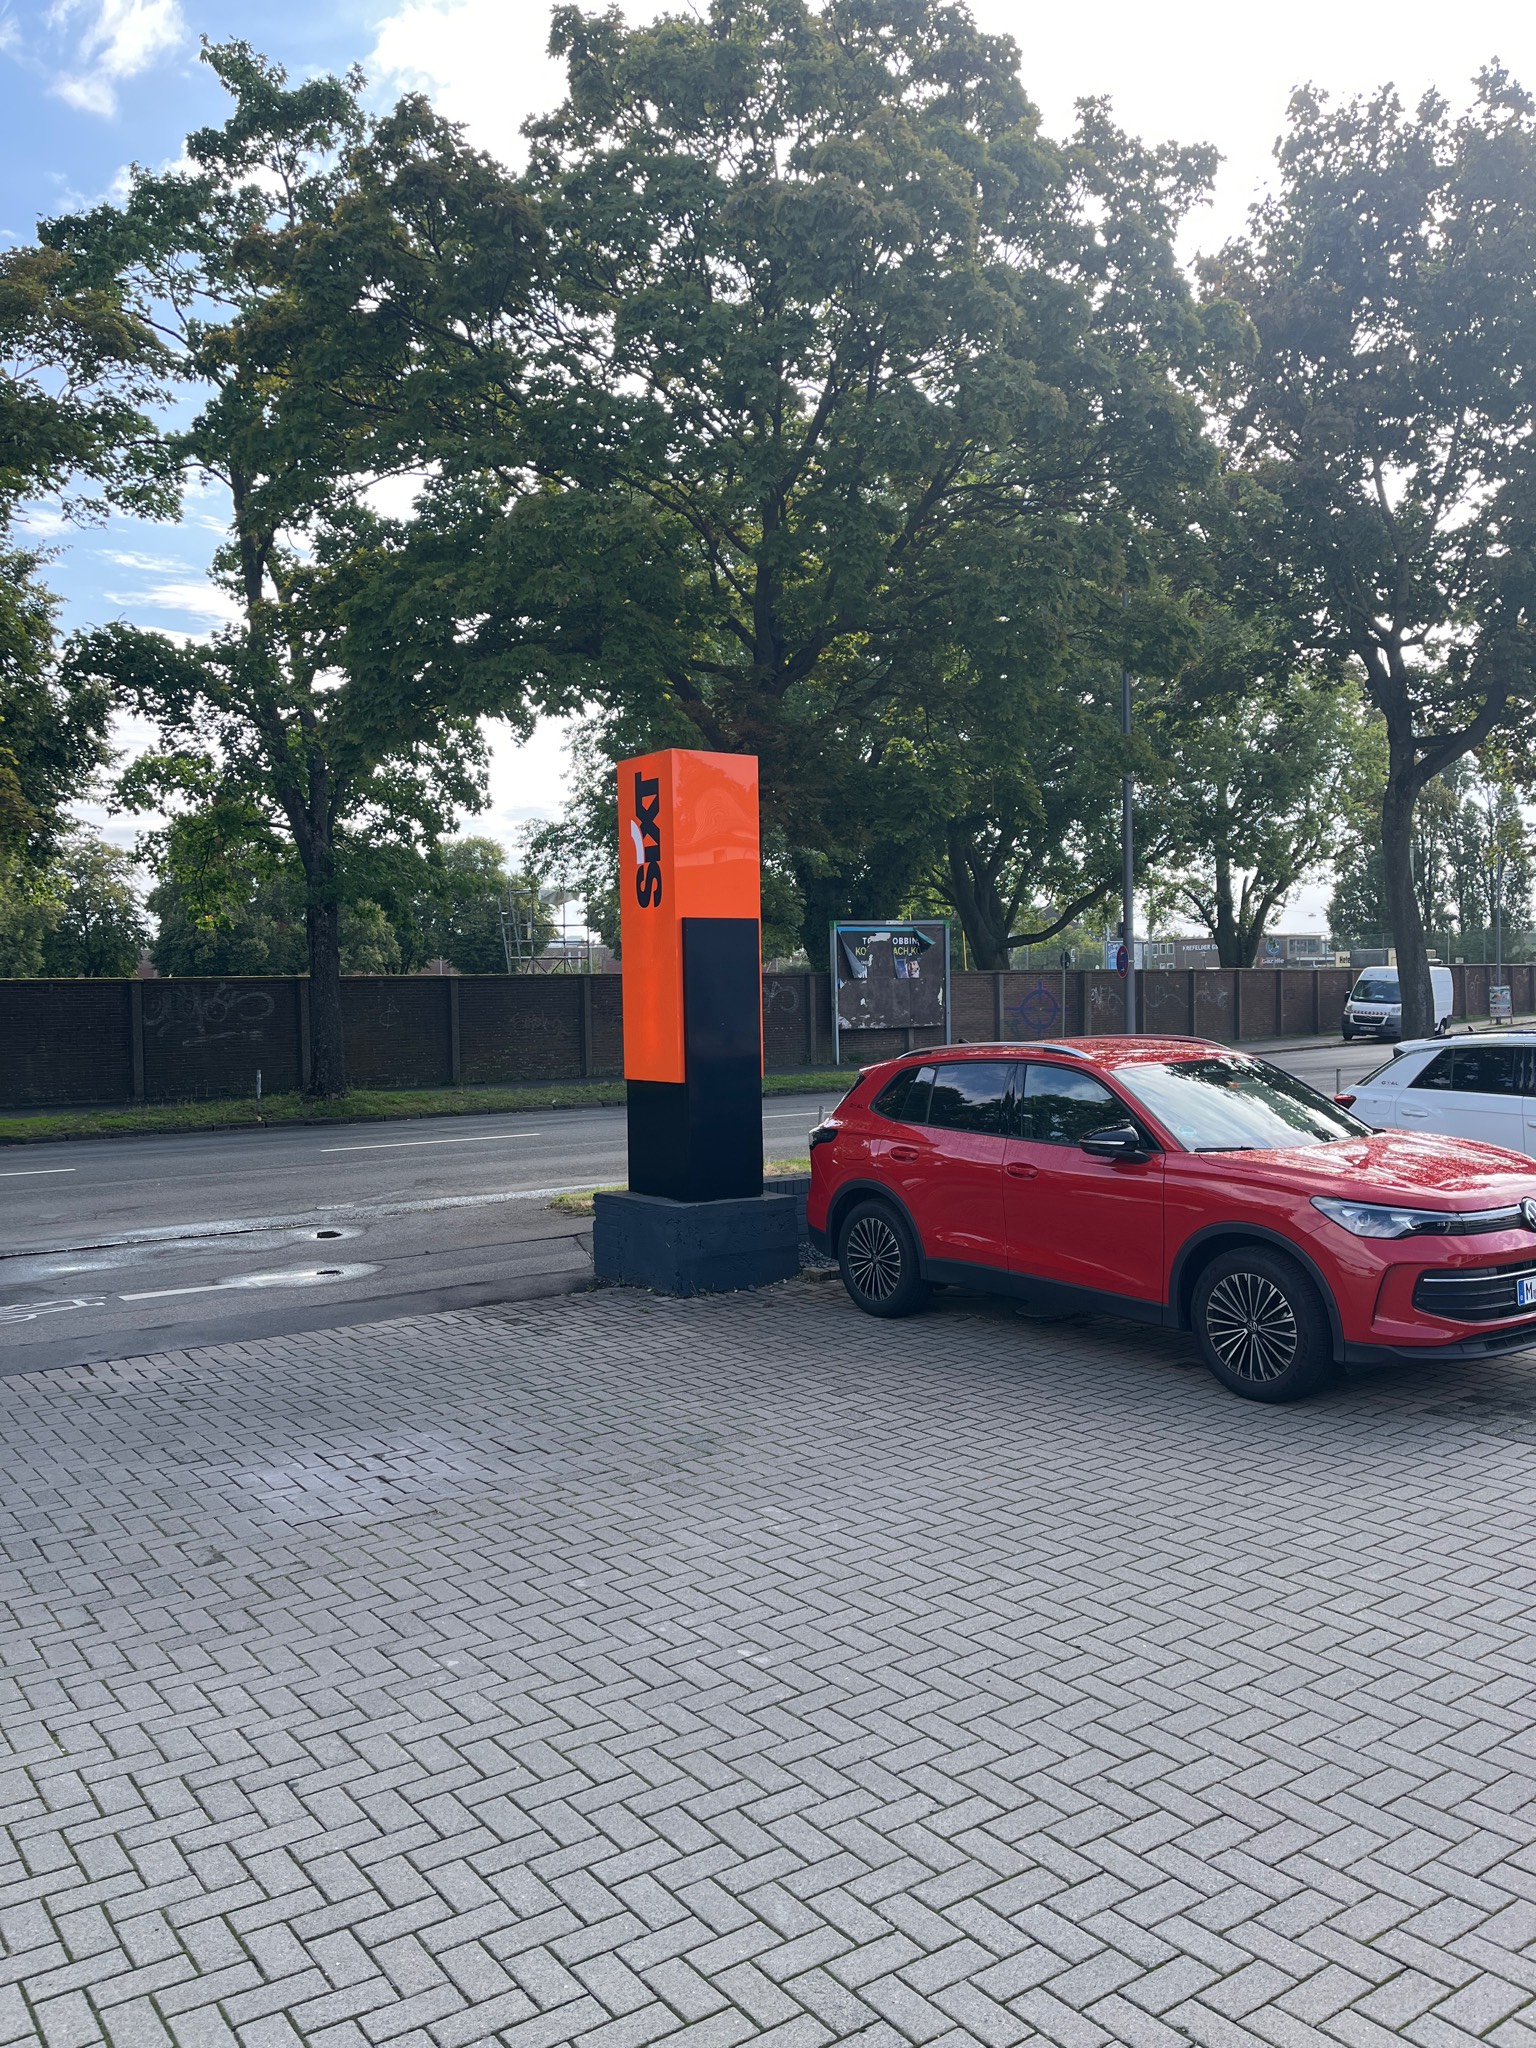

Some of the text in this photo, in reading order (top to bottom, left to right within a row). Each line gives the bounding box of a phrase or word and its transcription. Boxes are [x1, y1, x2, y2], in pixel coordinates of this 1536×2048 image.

[630, 771, 662, 909] SIXT
[892, 937, 920, 946] OBBIN
[893, 946, 909, 956] ACH
